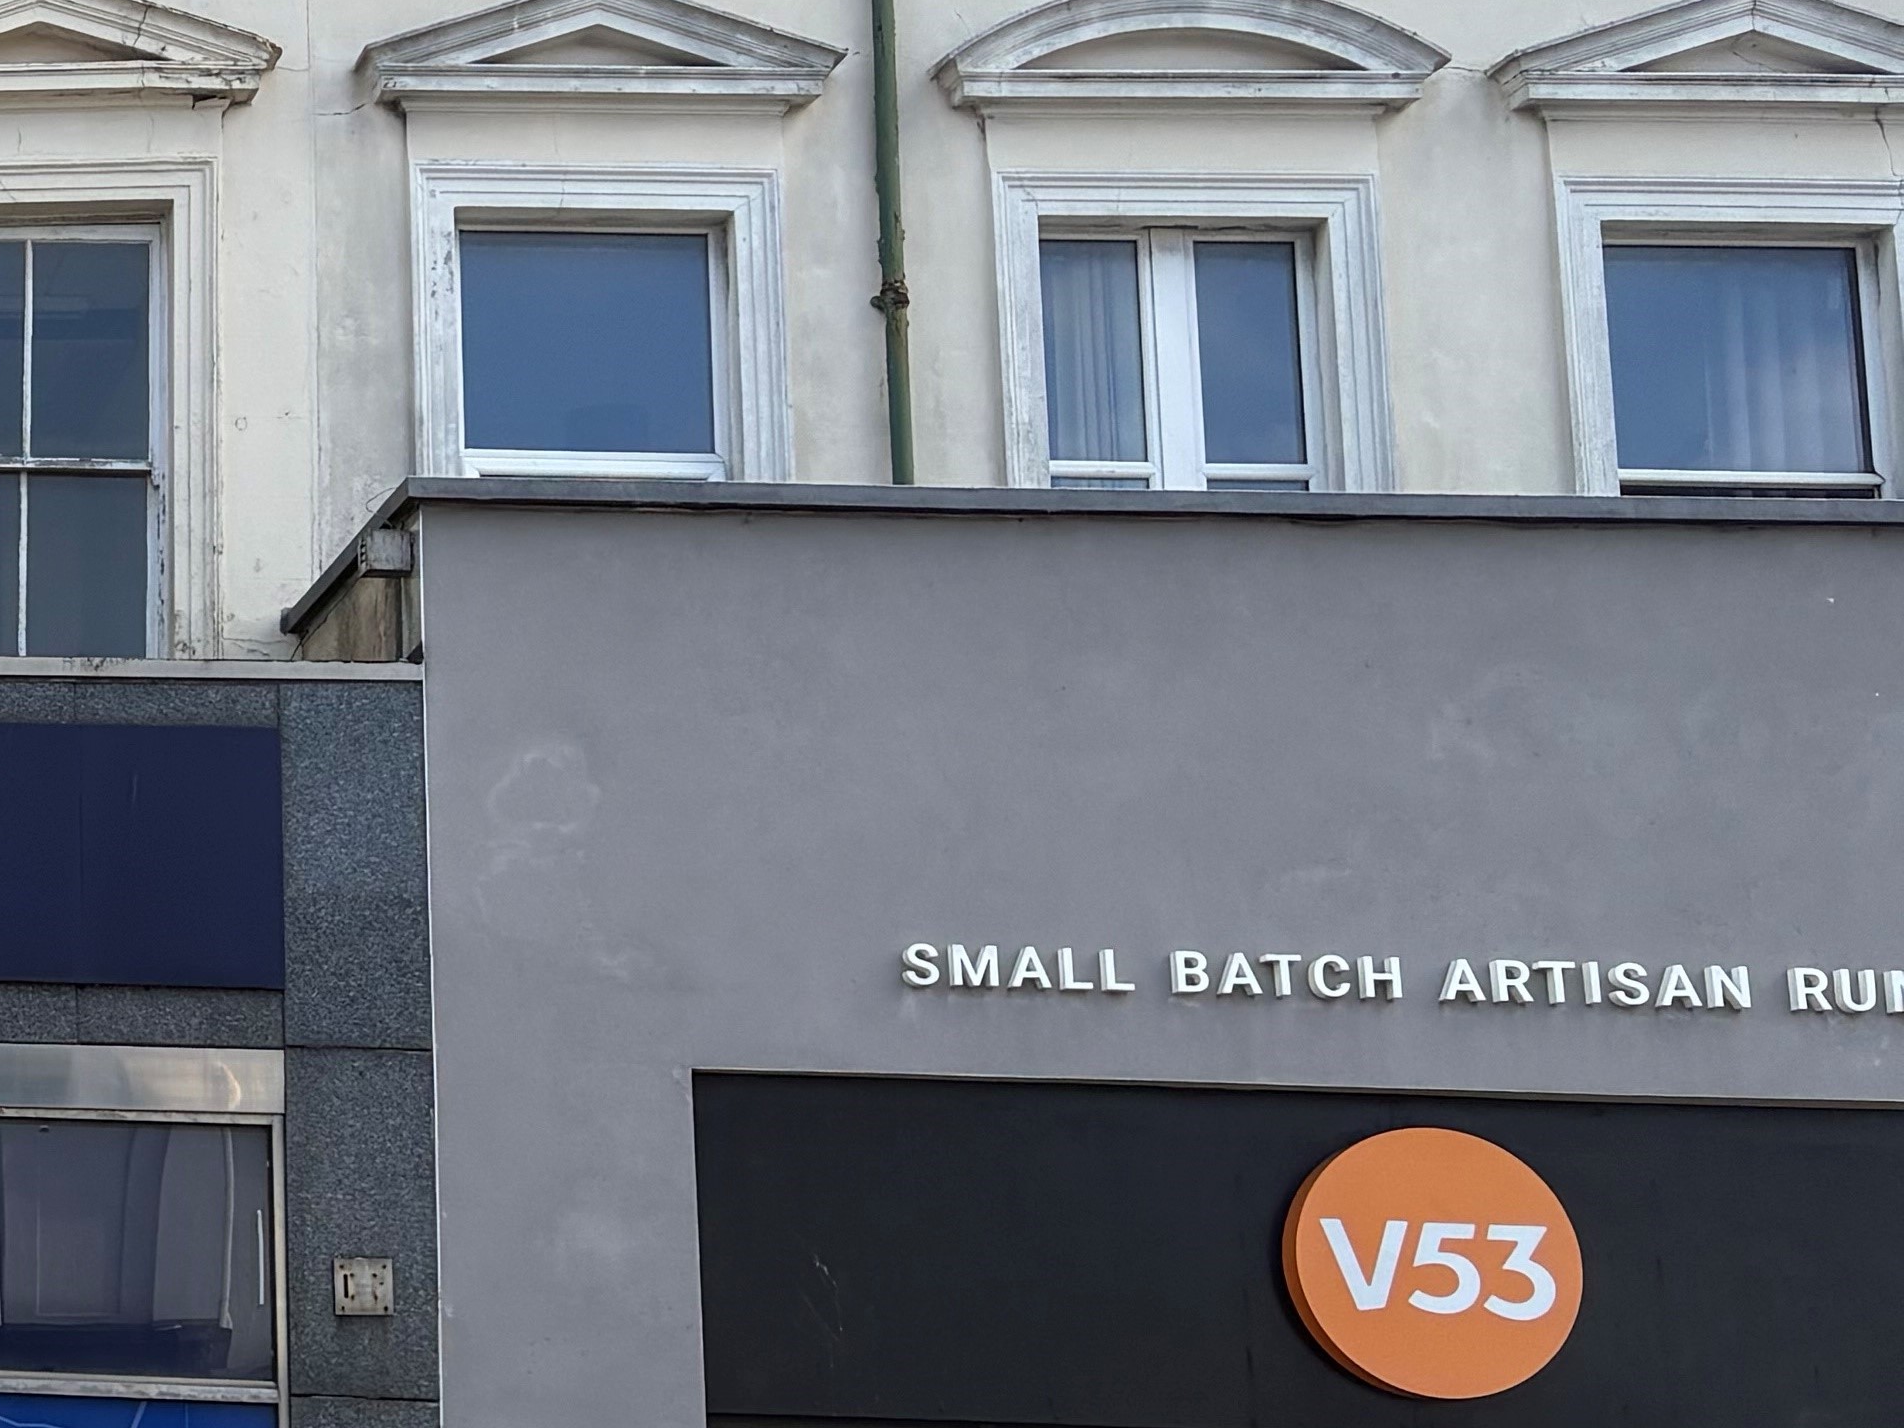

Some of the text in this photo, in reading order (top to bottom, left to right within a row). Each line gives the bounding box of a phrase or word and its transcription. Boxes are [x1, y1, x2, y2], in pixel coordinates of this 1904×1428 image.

[901, 942, 1136, 993] SMALL
[1169, 949, 1404, 1000] BATCH
[1438, 957, 1753, 1010] ARTISAN
[1319, 1218, 1557, 1321] V53
